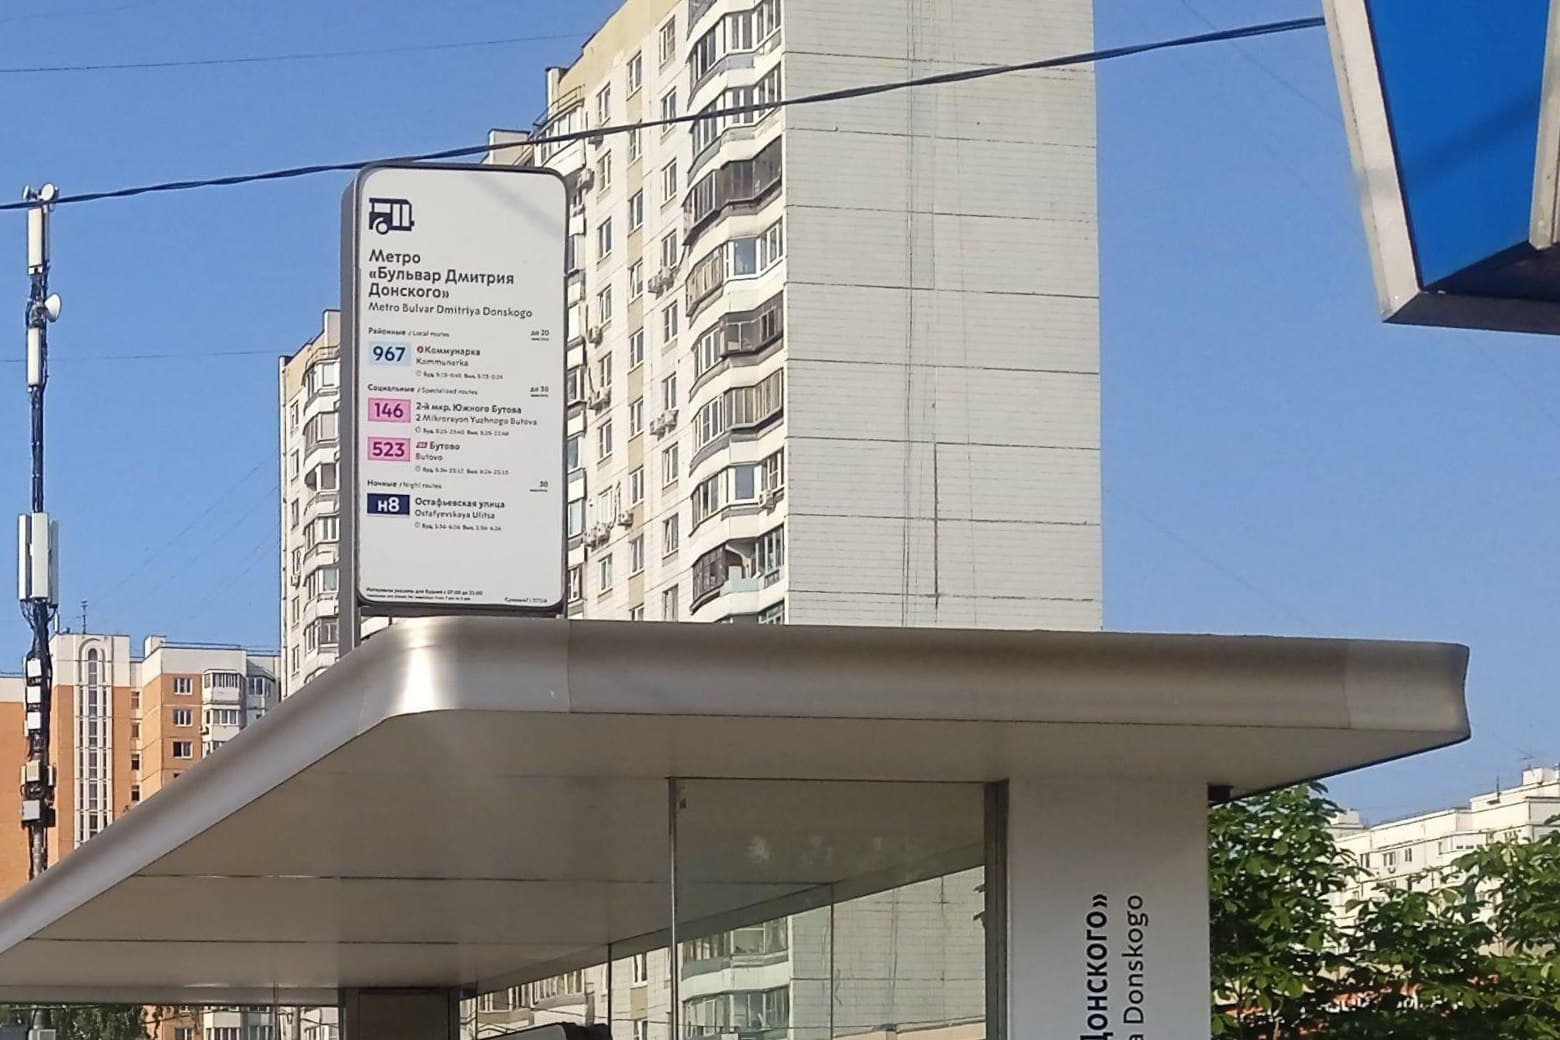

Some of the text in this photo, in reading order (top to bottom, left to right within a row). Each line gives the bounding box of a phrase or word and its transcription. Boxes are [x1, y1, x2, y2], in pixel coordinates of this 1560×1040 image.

[368, 249, 421, 265] Метро
[368, 267, 515, 286] «Бульвар Дмитрия
[368, 283, 450, 300] Донского»
[368, 302, 533, 320] Metro Bulvar Dmitriya Donskogo
[372, 345, 406, 362] 967
[424, 346, 481, 357] Коммунарка
[374, 402, 404, 418] 146
[452, 403, 490, 414] Южного
[491, 404, 522, 415] Бутова
[415, 413, 421, 422] 2
[372, 441, 405, 458] 523
[429, 441, 460, 451] Бутово
[415, 452, 443, 461] Butovo
[377, 496, 400, 512] н8
[415, 497, 506, 509] Остафьевская улица
[1123, 894, 1149, 1026] Donskogo
